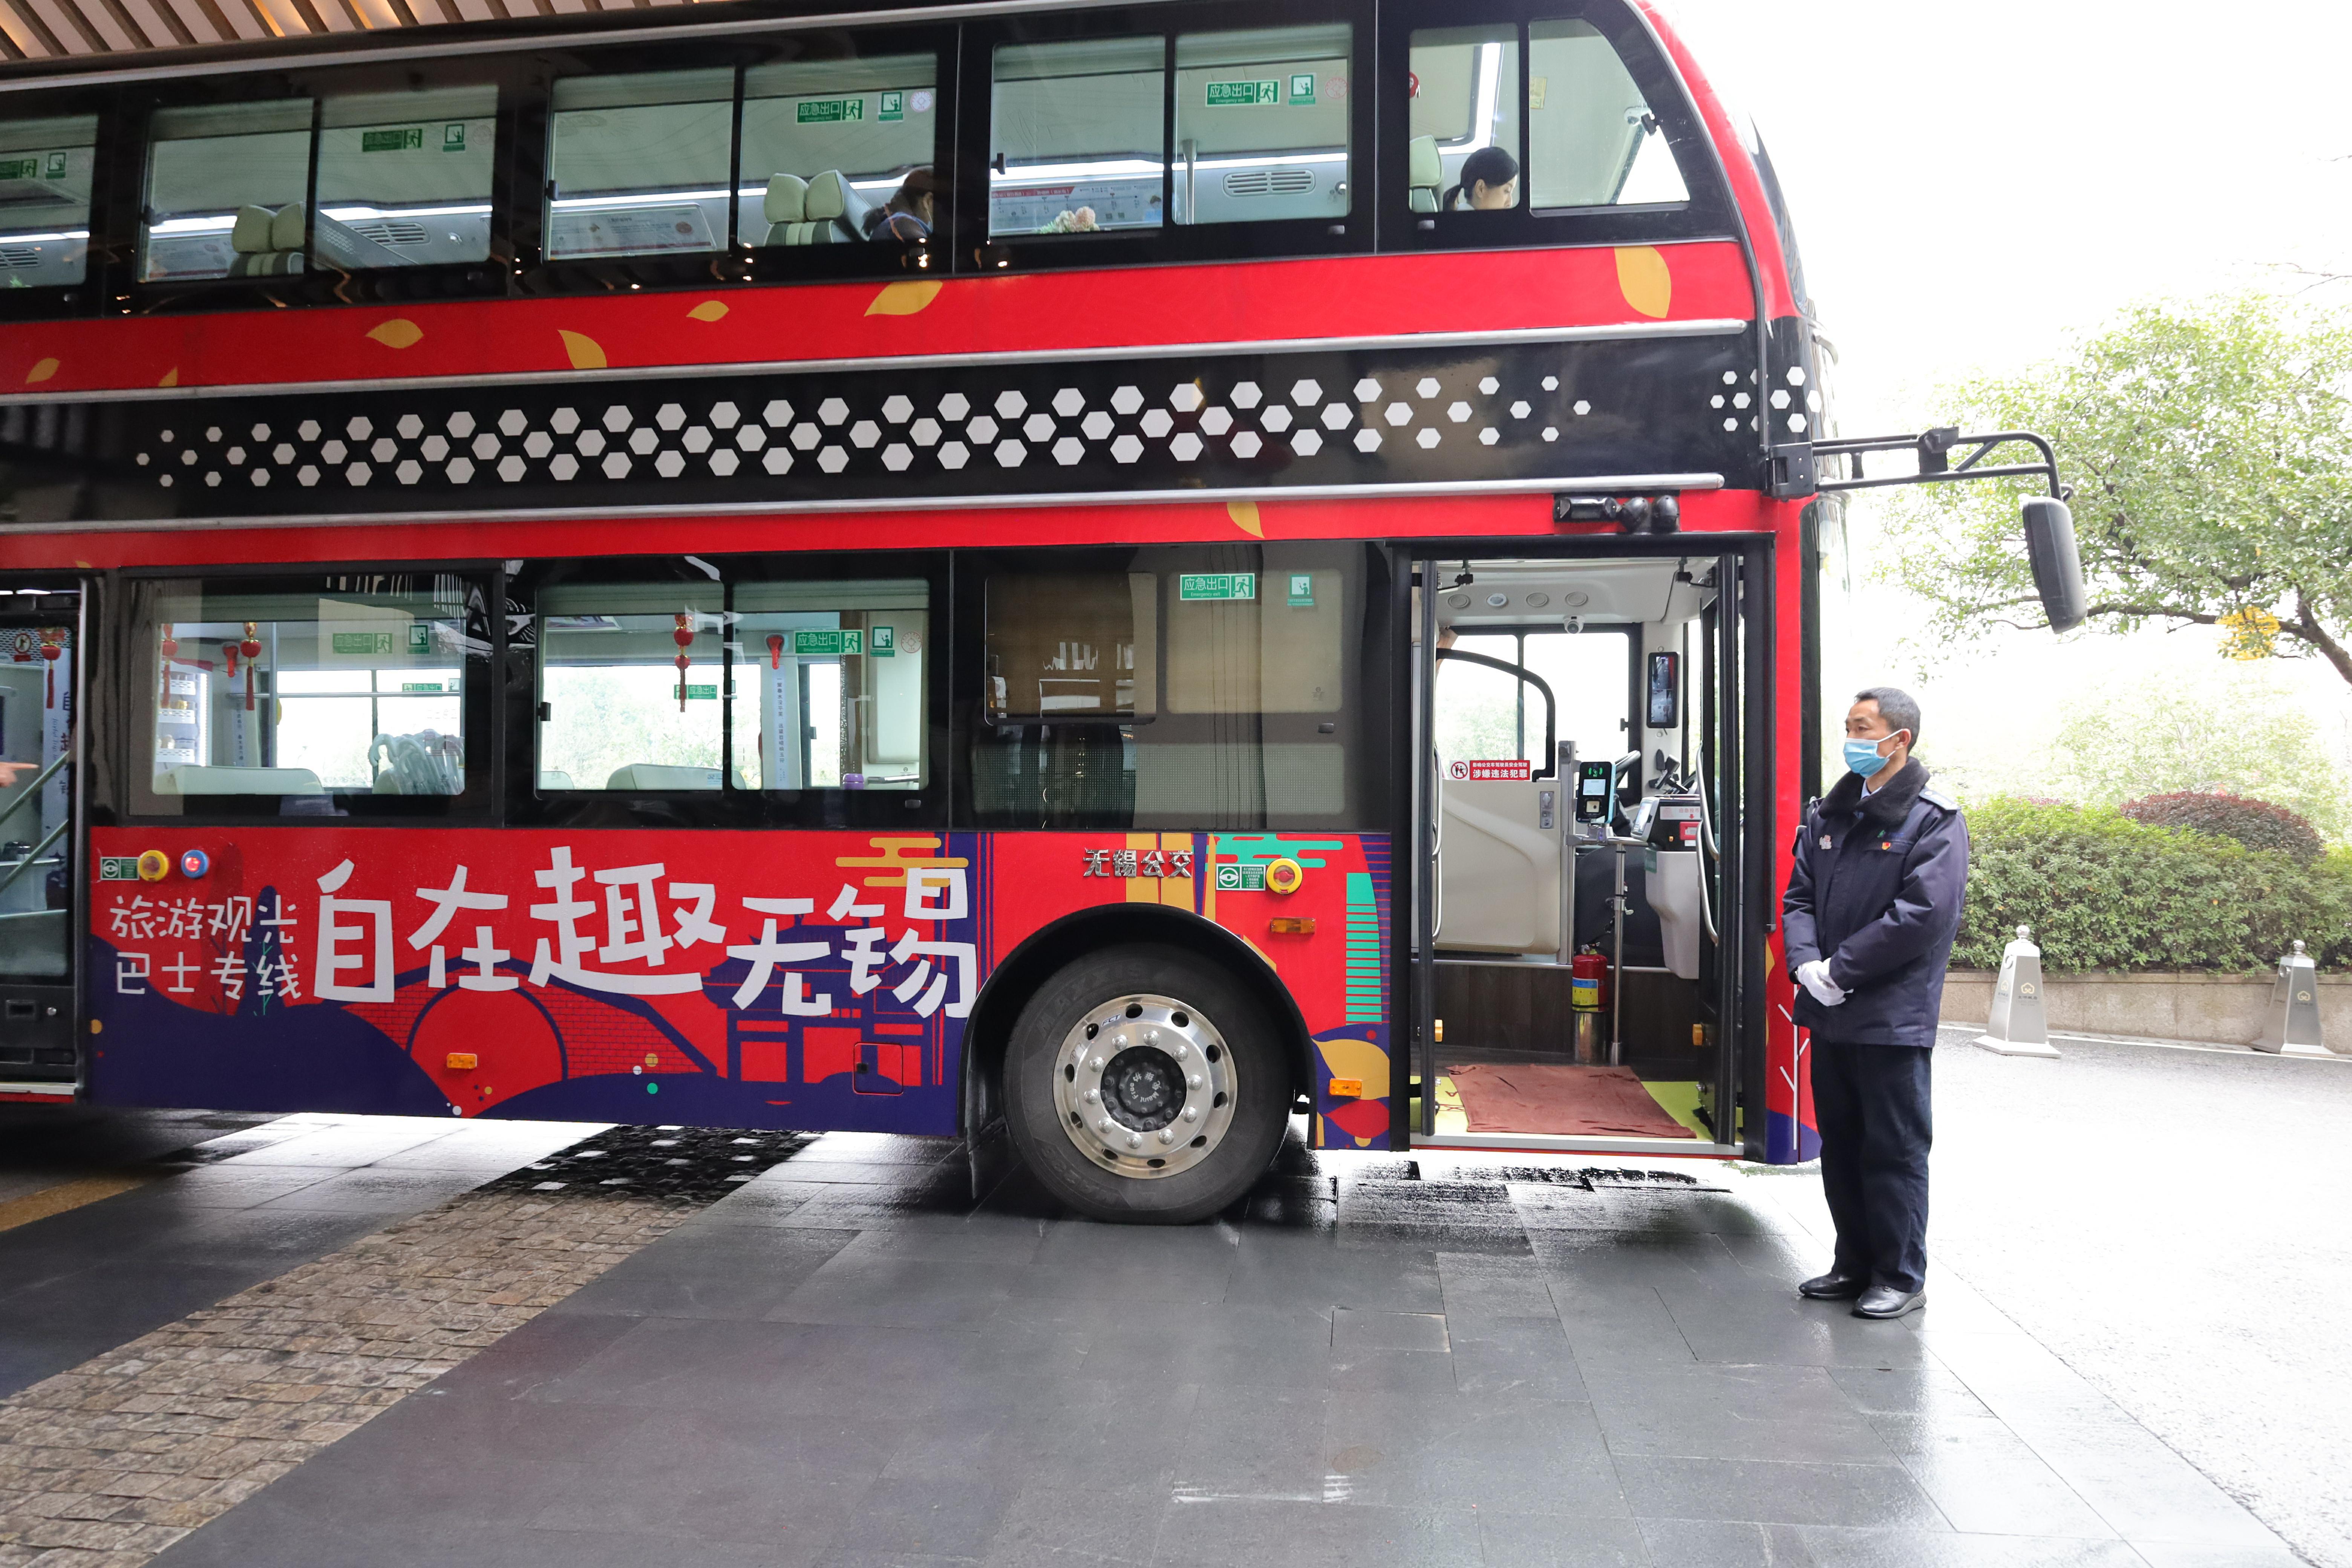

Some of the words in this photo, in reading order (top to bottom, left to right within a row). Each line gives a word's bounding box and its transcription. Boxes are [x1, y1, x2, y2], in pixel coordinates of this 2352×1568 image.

[1210, 84, 1253, 98] 应急出口
[799, 103, 840, 115] 应急出口
[1184, 577, 1228, 591] 应急出口
[797, 633, 839, 646] 应急出口
[689, 686, 716, 694] 应急出口
[1473, 769, 1528, 778] 涉嫌违法犯罪
[1083, 848, 1194, 877] 无锡公交
[110, 894, 297, 943] 旅游观光
[314, 845, 978, 1019] 自在趣无锡
[116, 951, 302, 1000] 巴士专线
[1102, 1014, 1121, 1026] FCT
[1130, 1083, 1139, 1099] Free
[1140, 1091, 1159, 1102] Maint
